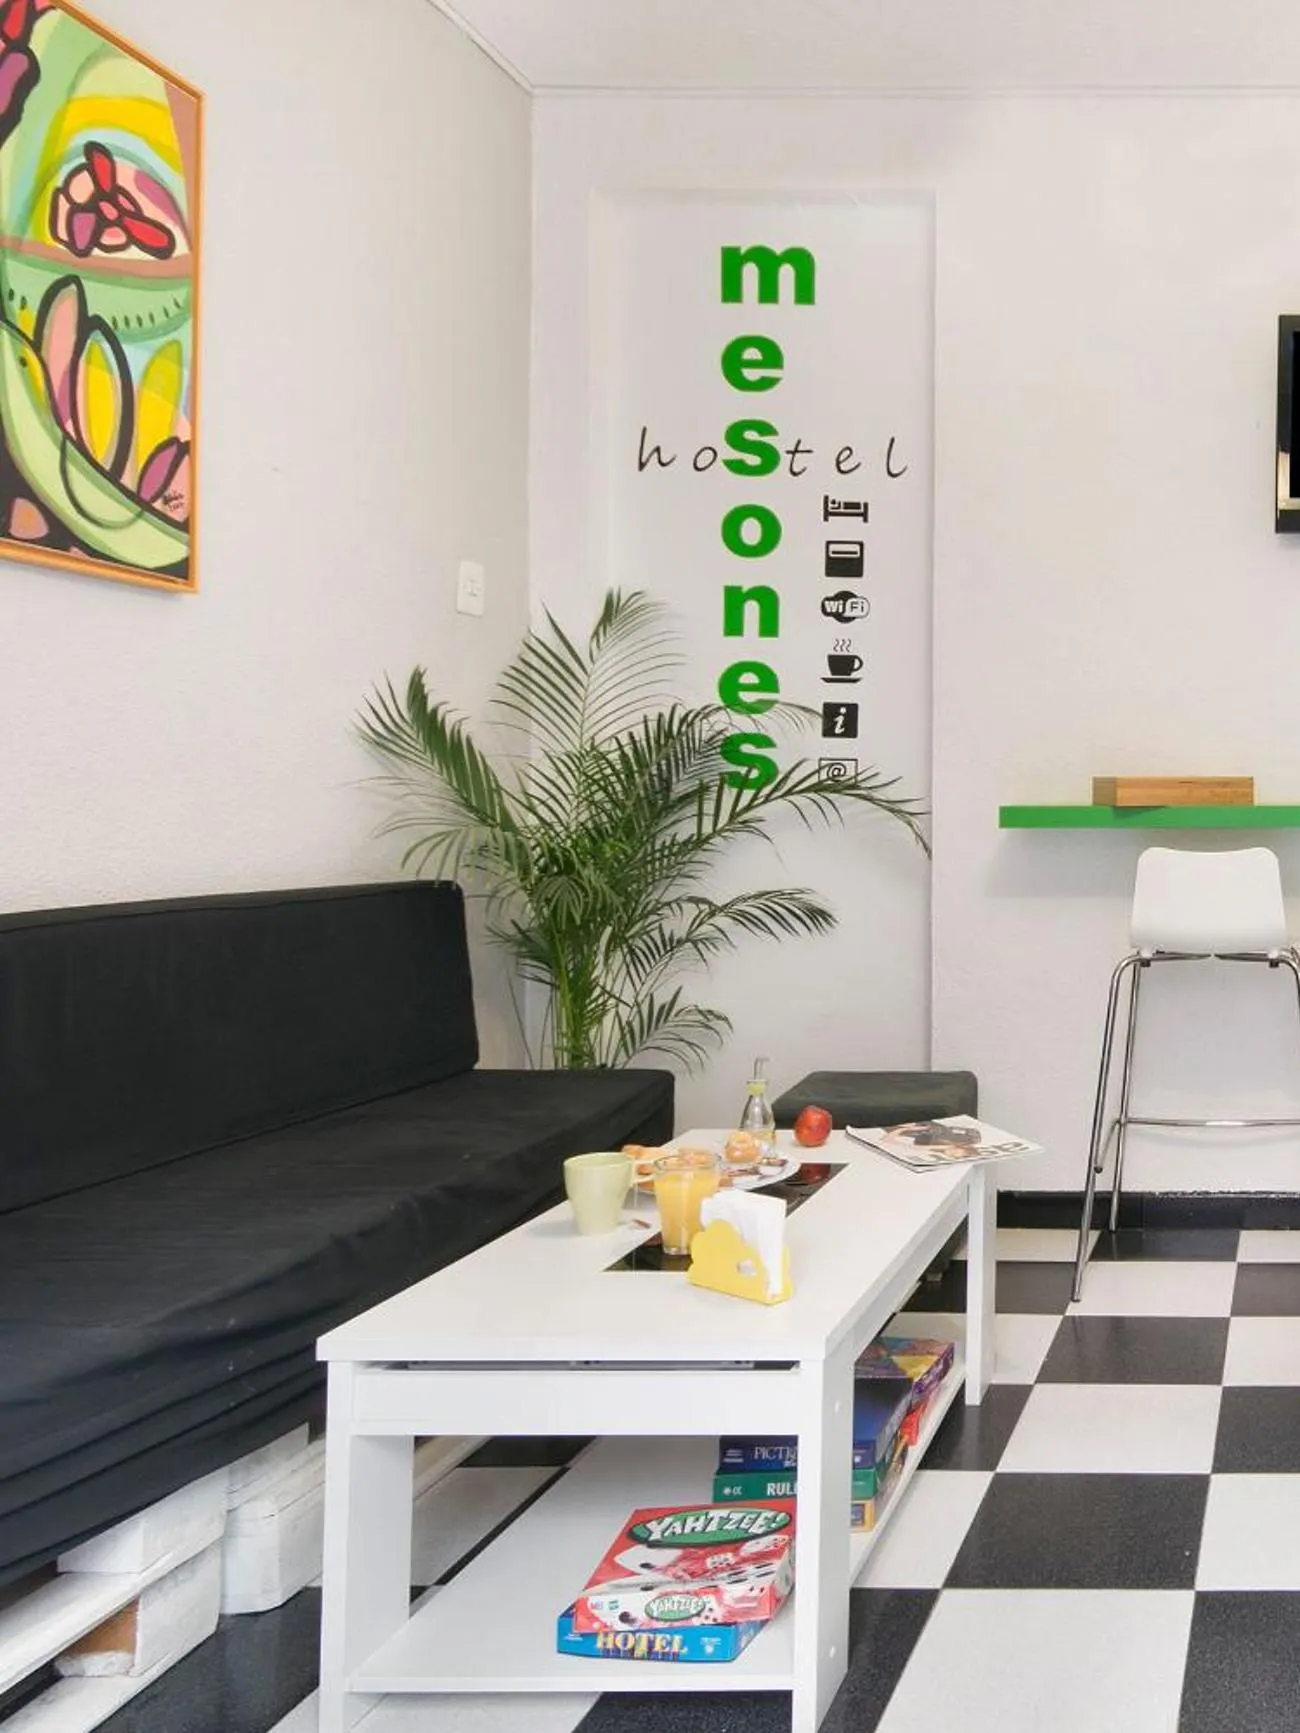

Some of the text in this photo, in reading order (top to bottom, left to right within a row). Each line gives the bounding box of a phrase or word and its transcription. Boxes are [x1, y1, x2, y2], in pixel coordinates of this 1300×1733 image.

[637, 426, 908, 479] hostel
[718, 245, 816, 790] mesones
[646, 1510, 788, 1541] YAHTZEE!
[595, 1631, 688, 1655] HOTEL
